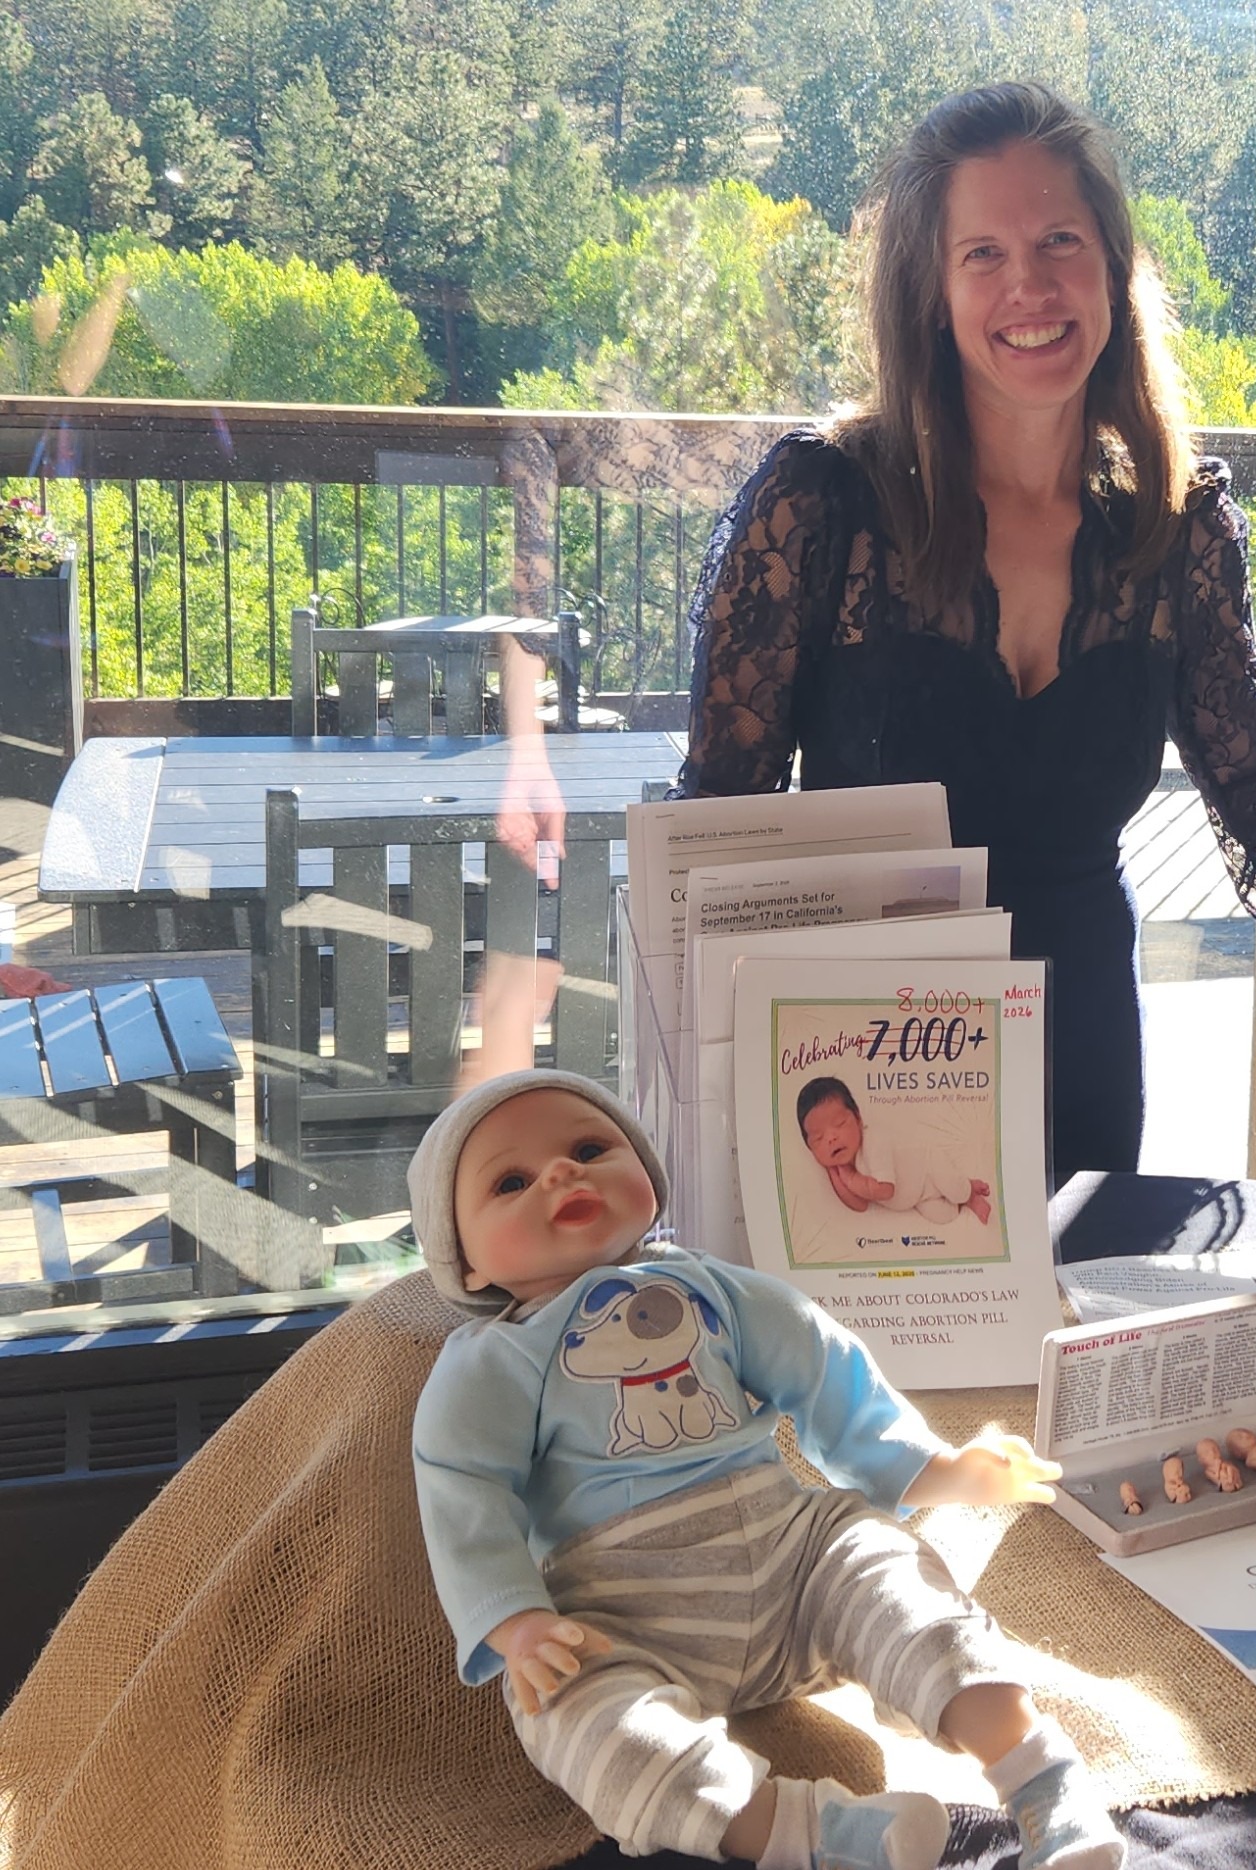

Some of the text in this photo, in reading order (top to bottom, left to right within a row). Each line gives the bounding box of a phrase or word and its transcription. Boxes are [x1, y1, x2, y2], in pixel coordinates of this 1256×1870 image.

[701, 892, 835, 913] Closing Arguments Set for
[701, 905, 843, 928] September 17 in California's
[1004, 984, 1041, 1000] March
[1004, 1006, 1033, 1018] 2026
[781, 1017, 989, 1075] Celebrating 7,000+
[867, 1071, 990, 1090] LIVES SAVED
[868, 1093, 989, 1105] Through Abortion Pill Reversal
[832, 1295, 852, 1307] ME
[856, 1294, 901, 1307] ABOUT
[905, 1291, 989, 1306] COLORADO'S
[992, 1289, 1020, 1301] LAW
[910, 1313, 978, 1327] ABORTION
[981, 1312, 1009, 1324] PILL
[890, 1332, 955, 1346] REVERSAL
[1061, 1330, 1142, 1355] Touch of Life
